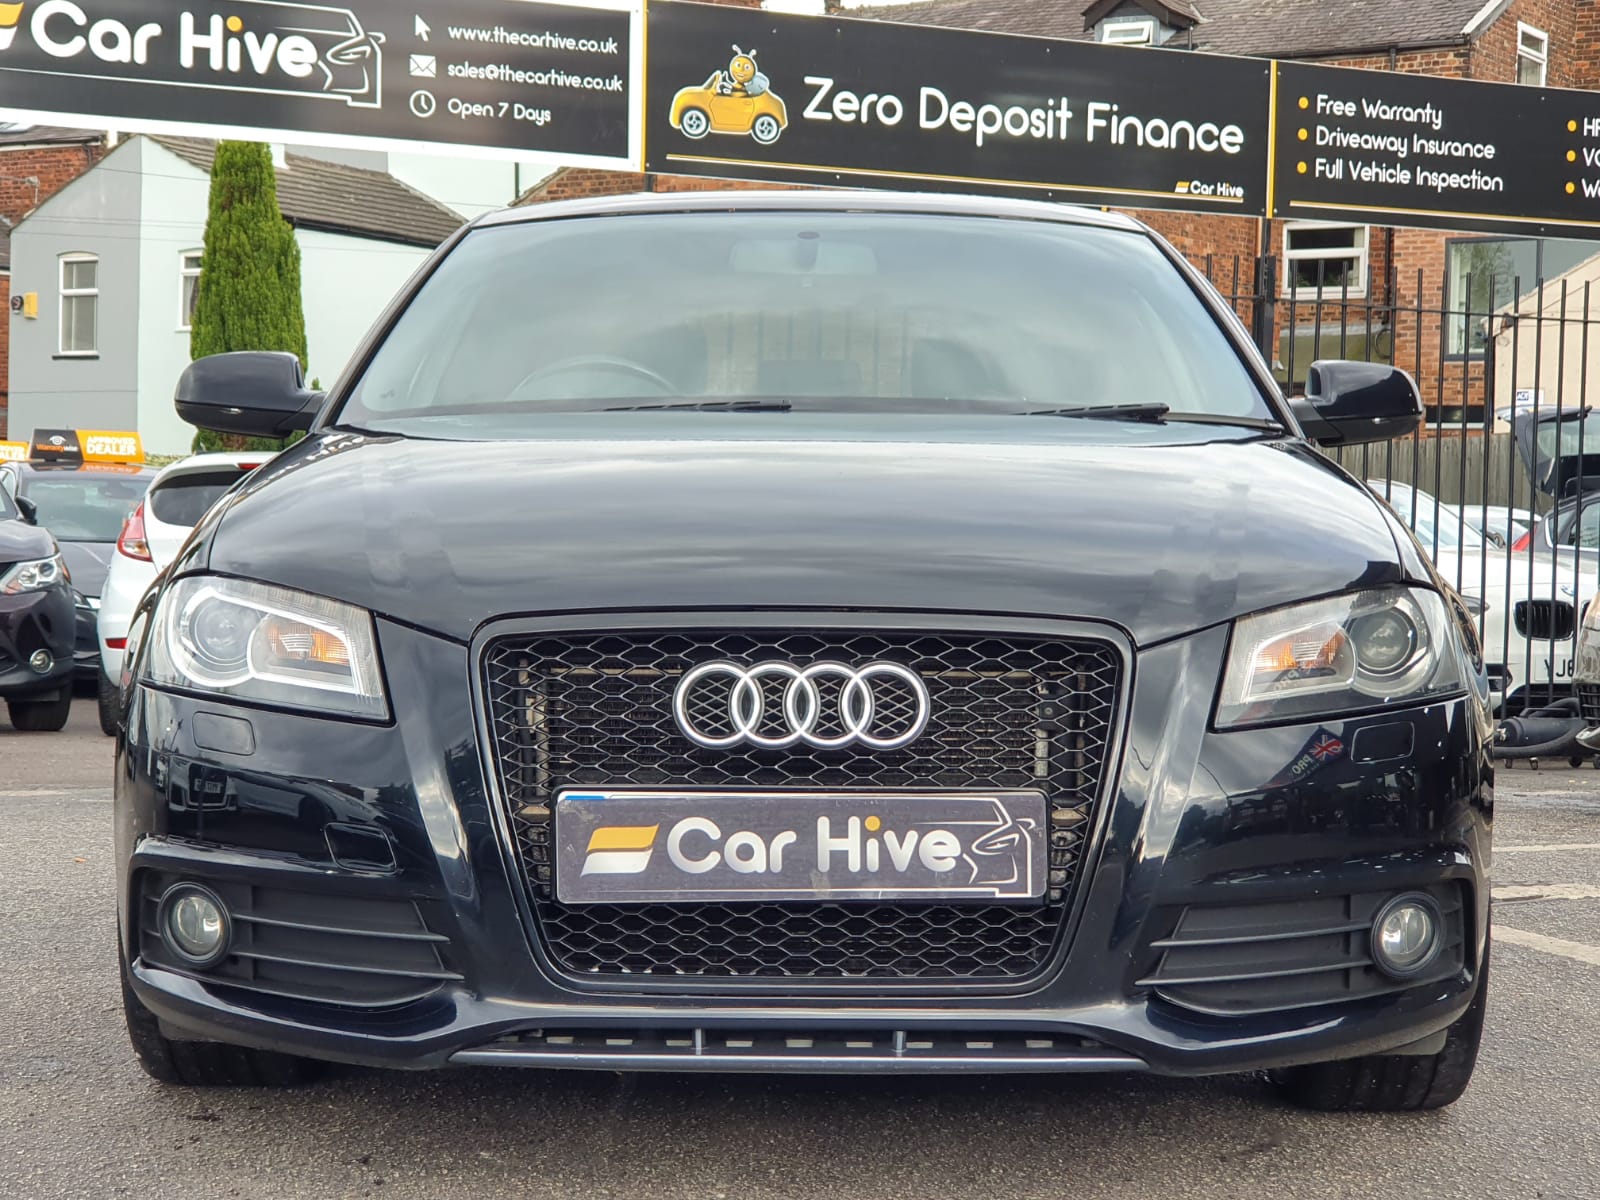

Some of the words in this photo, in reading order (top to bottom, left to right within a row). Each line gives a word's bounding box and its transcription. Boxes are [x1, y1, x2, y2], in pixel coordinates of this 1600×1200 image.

[30, 0, 162, 65] Car
[180, 11, 318, 78] Hive
[448, 26, 618, 54] www.thecarhive.co.uk
[447, 61, 623, 92] sales@thecarhive.co.uk
[447, 97, 494, 119] Open
[497, 102, 509, 118] 7
[513, 103, 551, 126] Days
[803, 76, 903, 126] Zero
[919, 87, 1072, 147] Deposit
[1086, 103, 1244, 154] Finance
[1316, 94, 1357, 117] Free
[1361, 97, 1443, 131] Warranty
[1315, 125, 1408, 158] Driveaway
[1413, 133, 1496, 160] Insurance
[1190, 180, 1215, 195] Car
[1217, 182, 1244, 197] Hive
[1315, 157, 1343, 180] Full
[1348, 160, 1412, 185] Vehicle
[1416, 165, 1504, 193] Inspection
[1581, 178, 1600, 198] W
[86, 444, 137, 456] DEALER
[667, 817, 797, 874] Car
[816, 816, 961, 873] Hive
